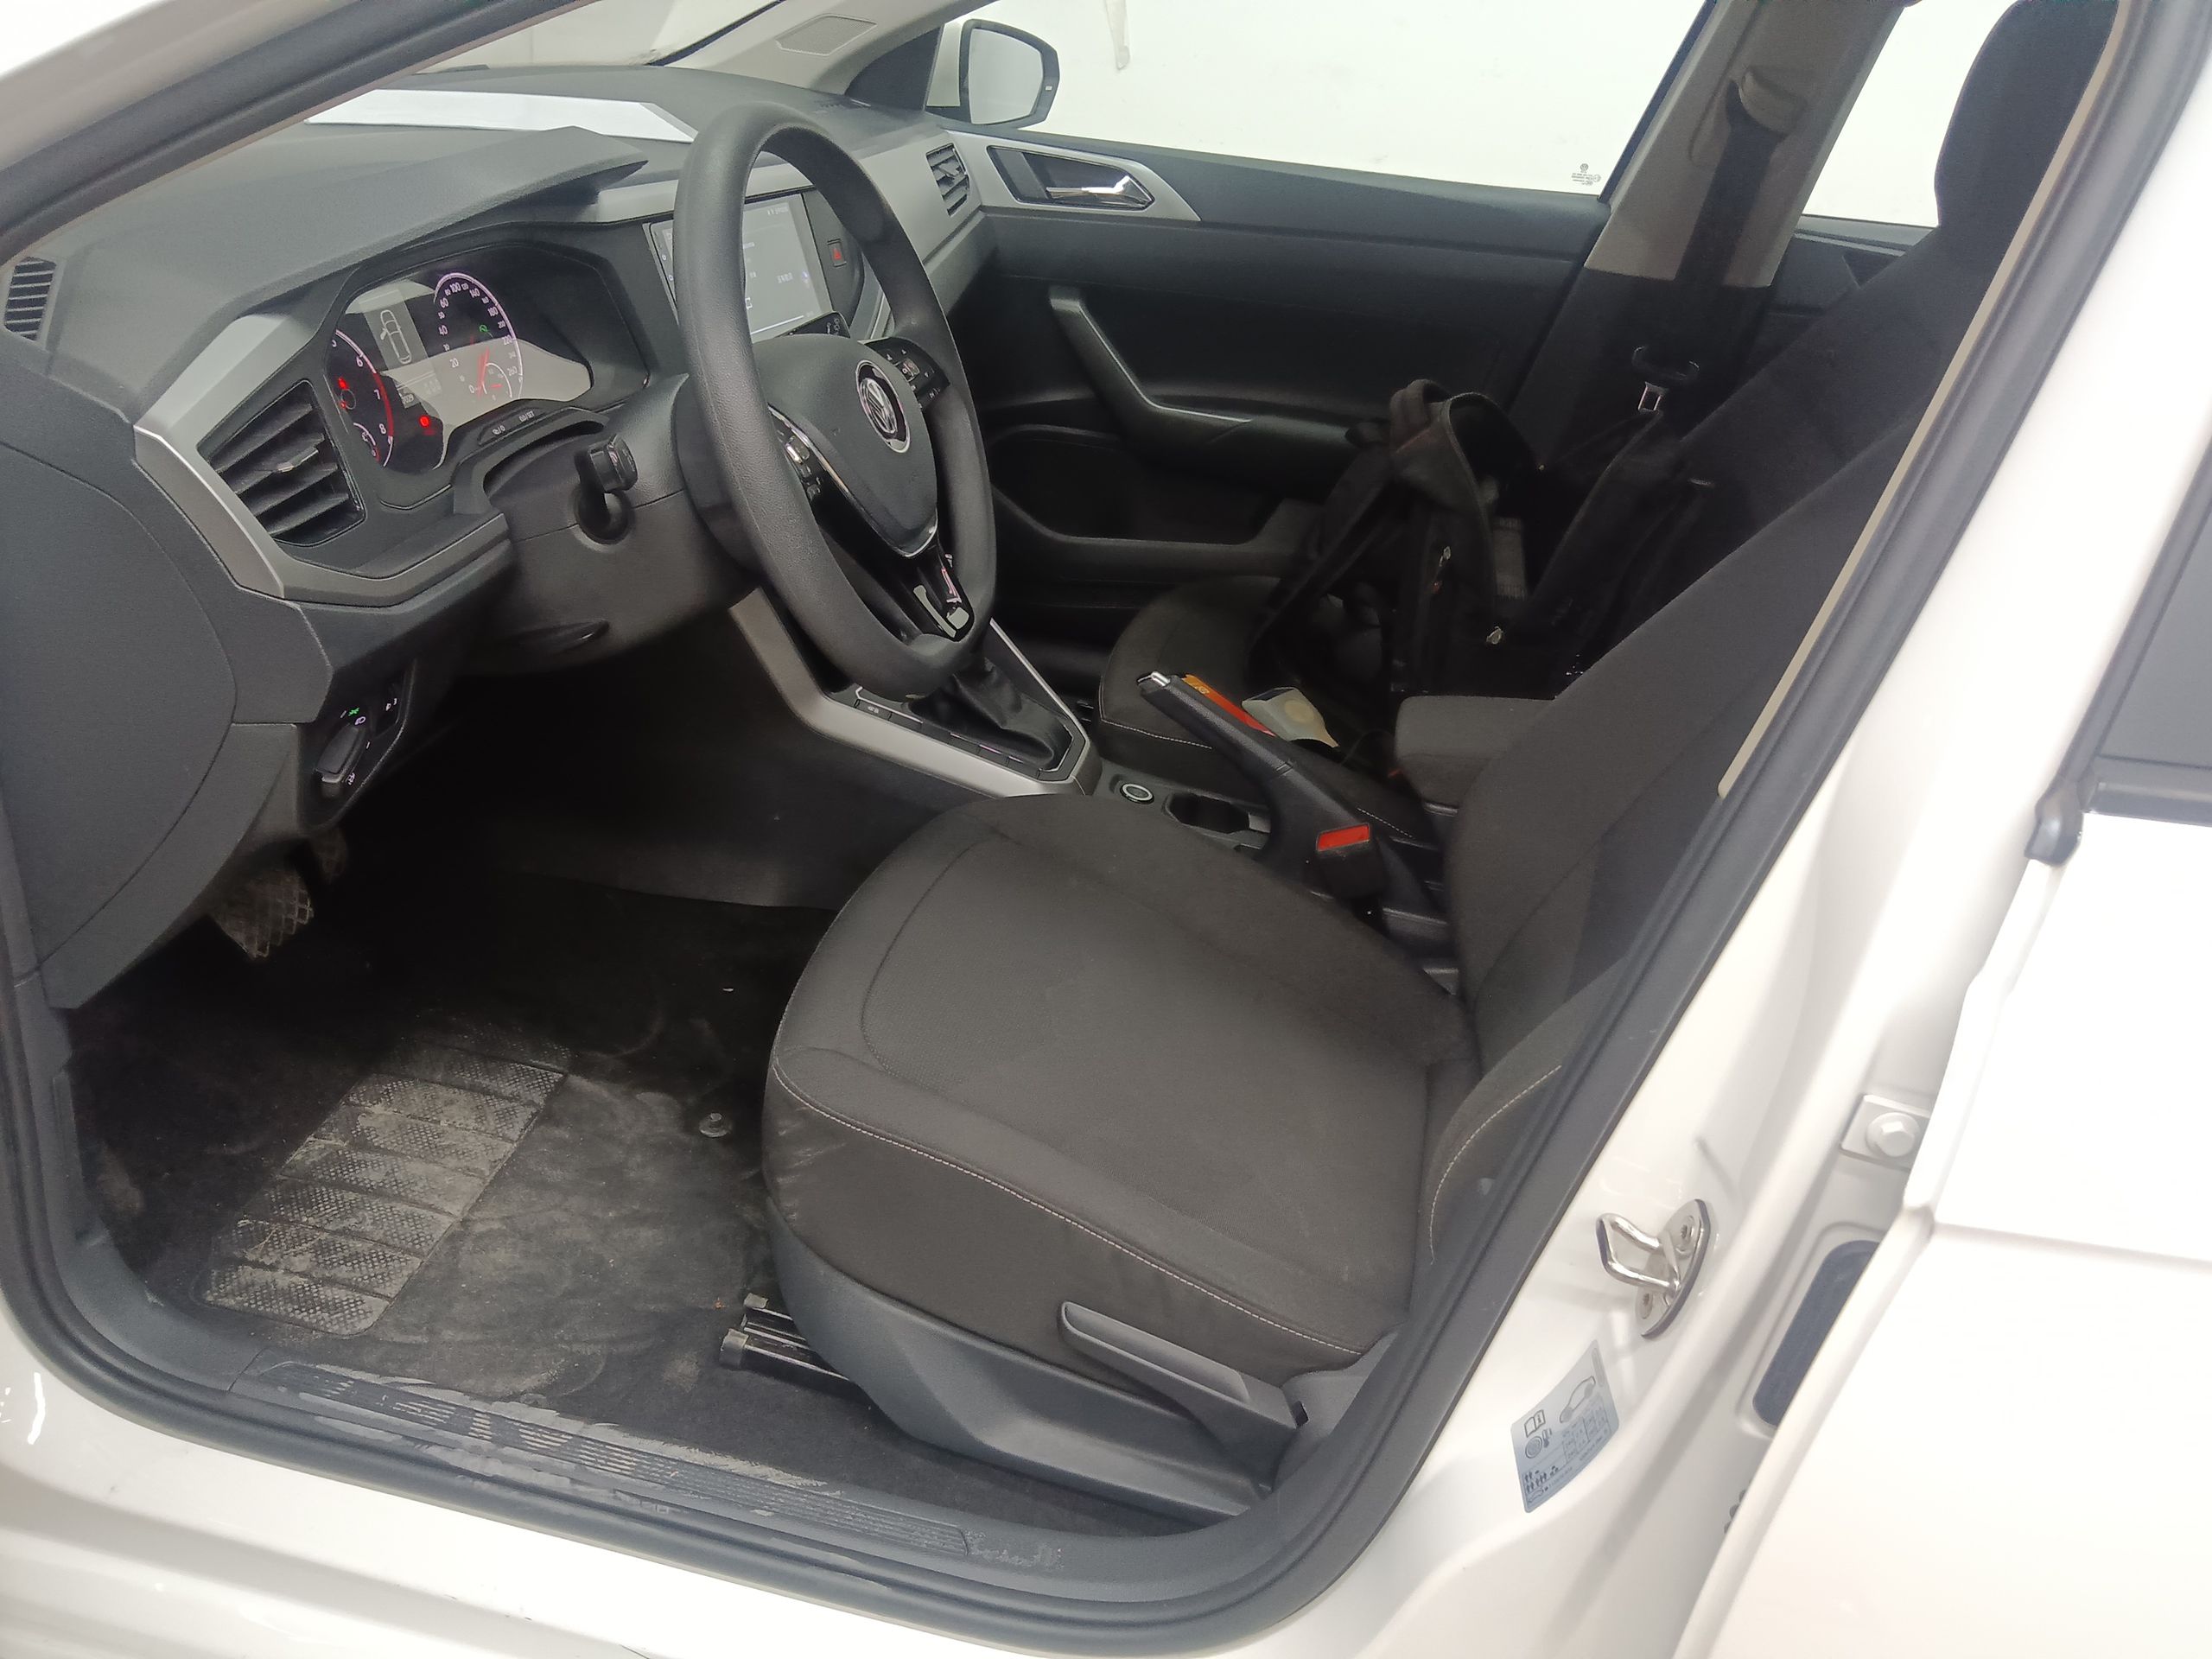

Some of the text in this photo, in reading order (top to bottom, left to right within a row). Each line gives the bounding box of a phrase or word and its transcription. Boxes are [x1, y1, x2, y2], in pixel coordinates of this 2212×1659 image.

[450, 283, 461, 293] 100
[439, 325, 448, 335] 40
[356, 356, 363, 367] 6
[450, 358, 459, 368] 20
[469, 385, 474, 393] 0
[374, 390, 380, 400] 7
[379, 423, 386, 434] 8
